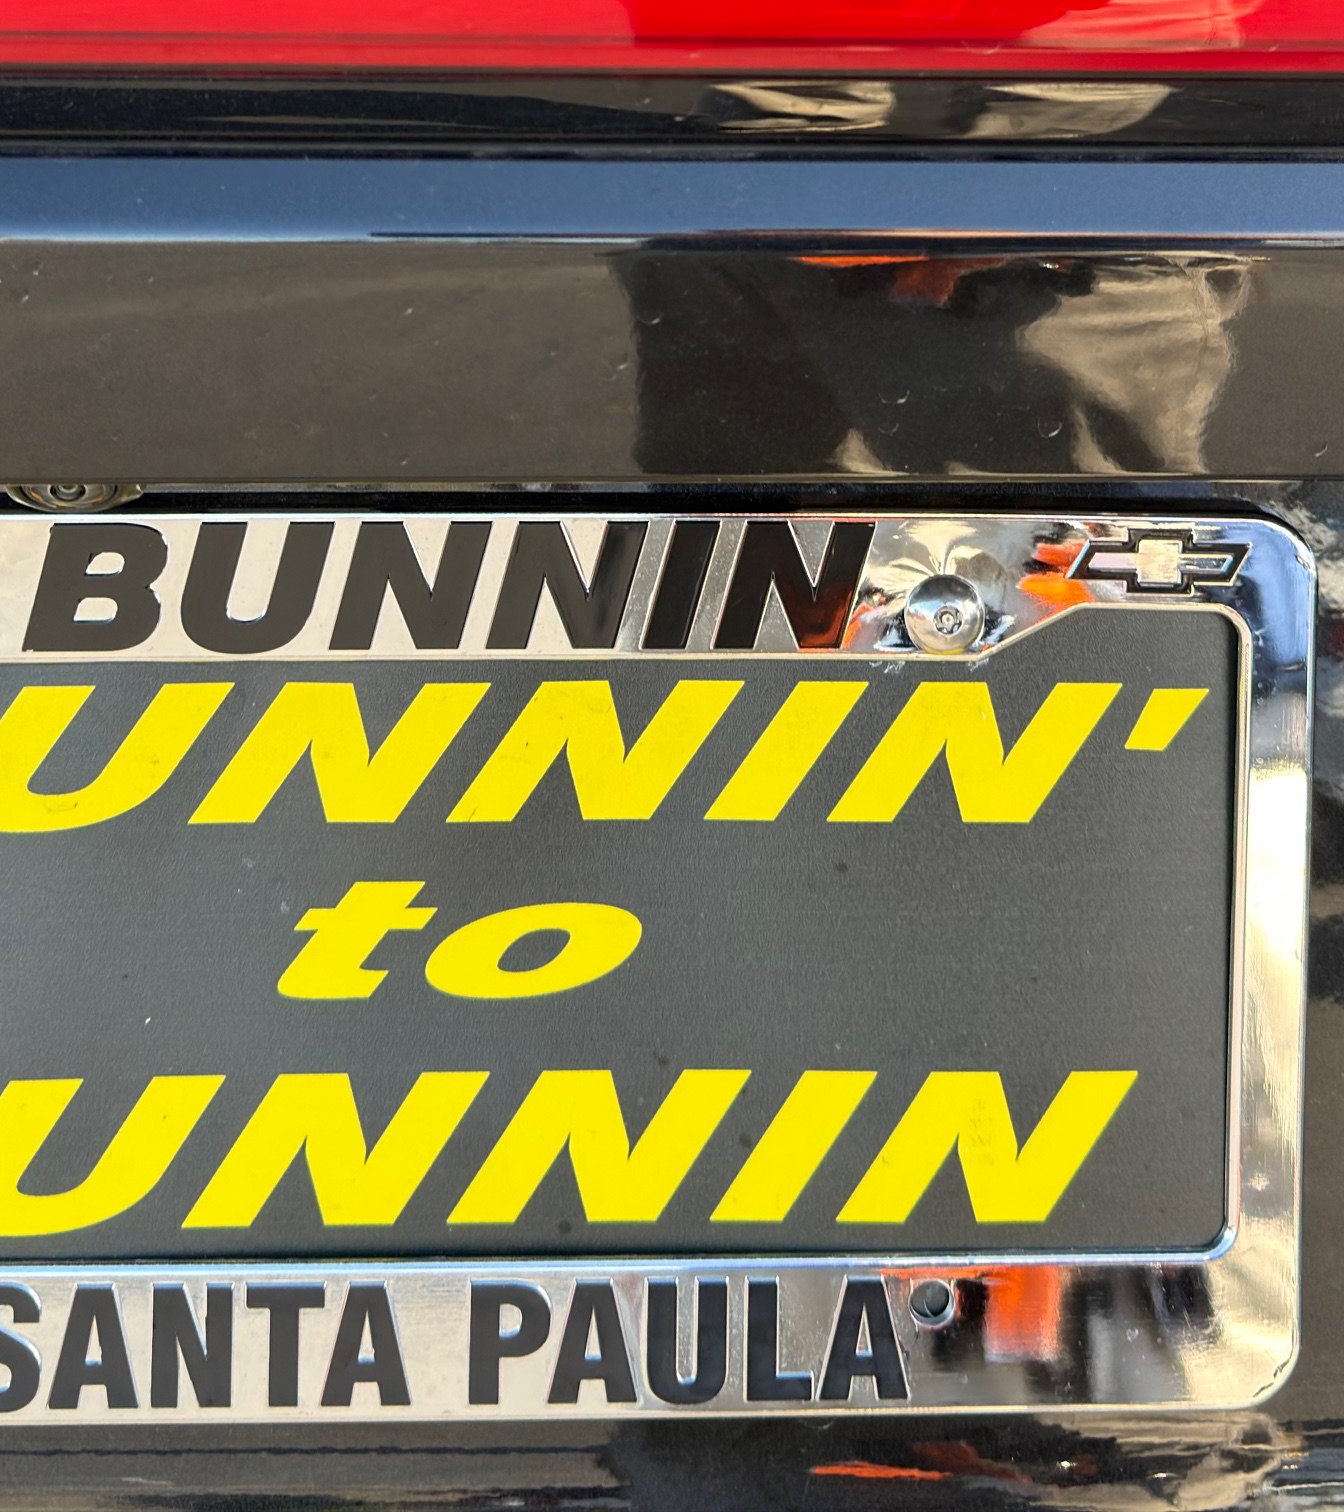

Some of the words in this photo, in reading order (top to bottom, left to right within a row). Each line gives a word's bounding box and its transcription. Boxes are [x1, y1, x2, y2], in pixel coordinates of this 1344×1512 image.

[23, 522, 875, 654] BUNNIN
[277, 881, 643, 1000] to
[467, 1278, 912, 1406] PAULA
